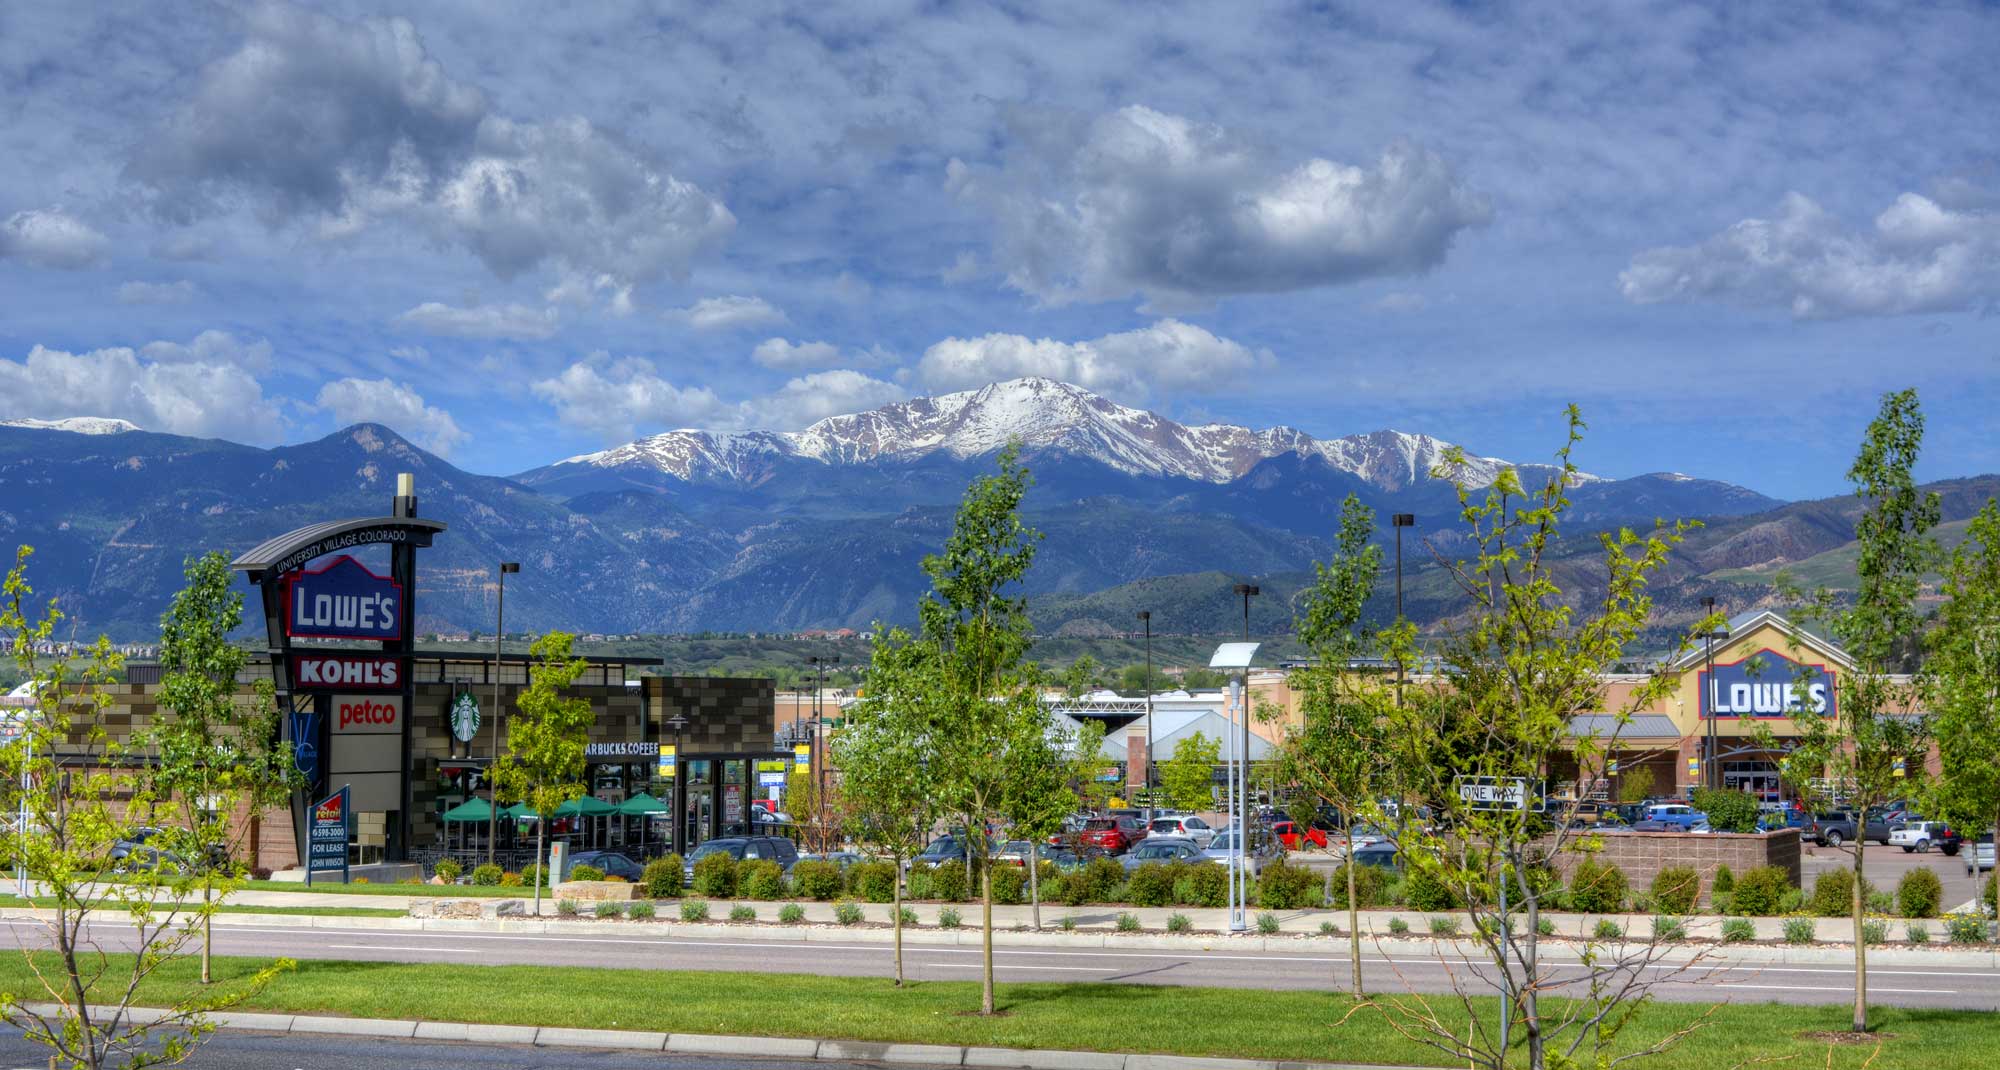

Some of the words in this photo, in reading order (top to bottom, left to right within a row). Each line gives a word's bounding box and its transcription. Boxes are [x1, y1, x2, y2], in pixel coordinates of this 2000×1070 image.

[277, 545, 321, 573] UNIVERSITY
[324, 534, 357, 551] VILLAGE
[359, 531, 406, 542] COLORADO
[297, 587, 394, 630] LOWE'S
[301, 660, 398, 684] KOHL'S
[1709, 679, 1826, 713] LOWES
[340, 699, 396, 730] petco
[585, 743, 626, 755] ARBUCKS
[627, 742, 658, 755] COFFEE
[316, 805, 341, 819] retail
[312, 844, 325, 853] FOR
[326, 843, 345, 853] LEASE
